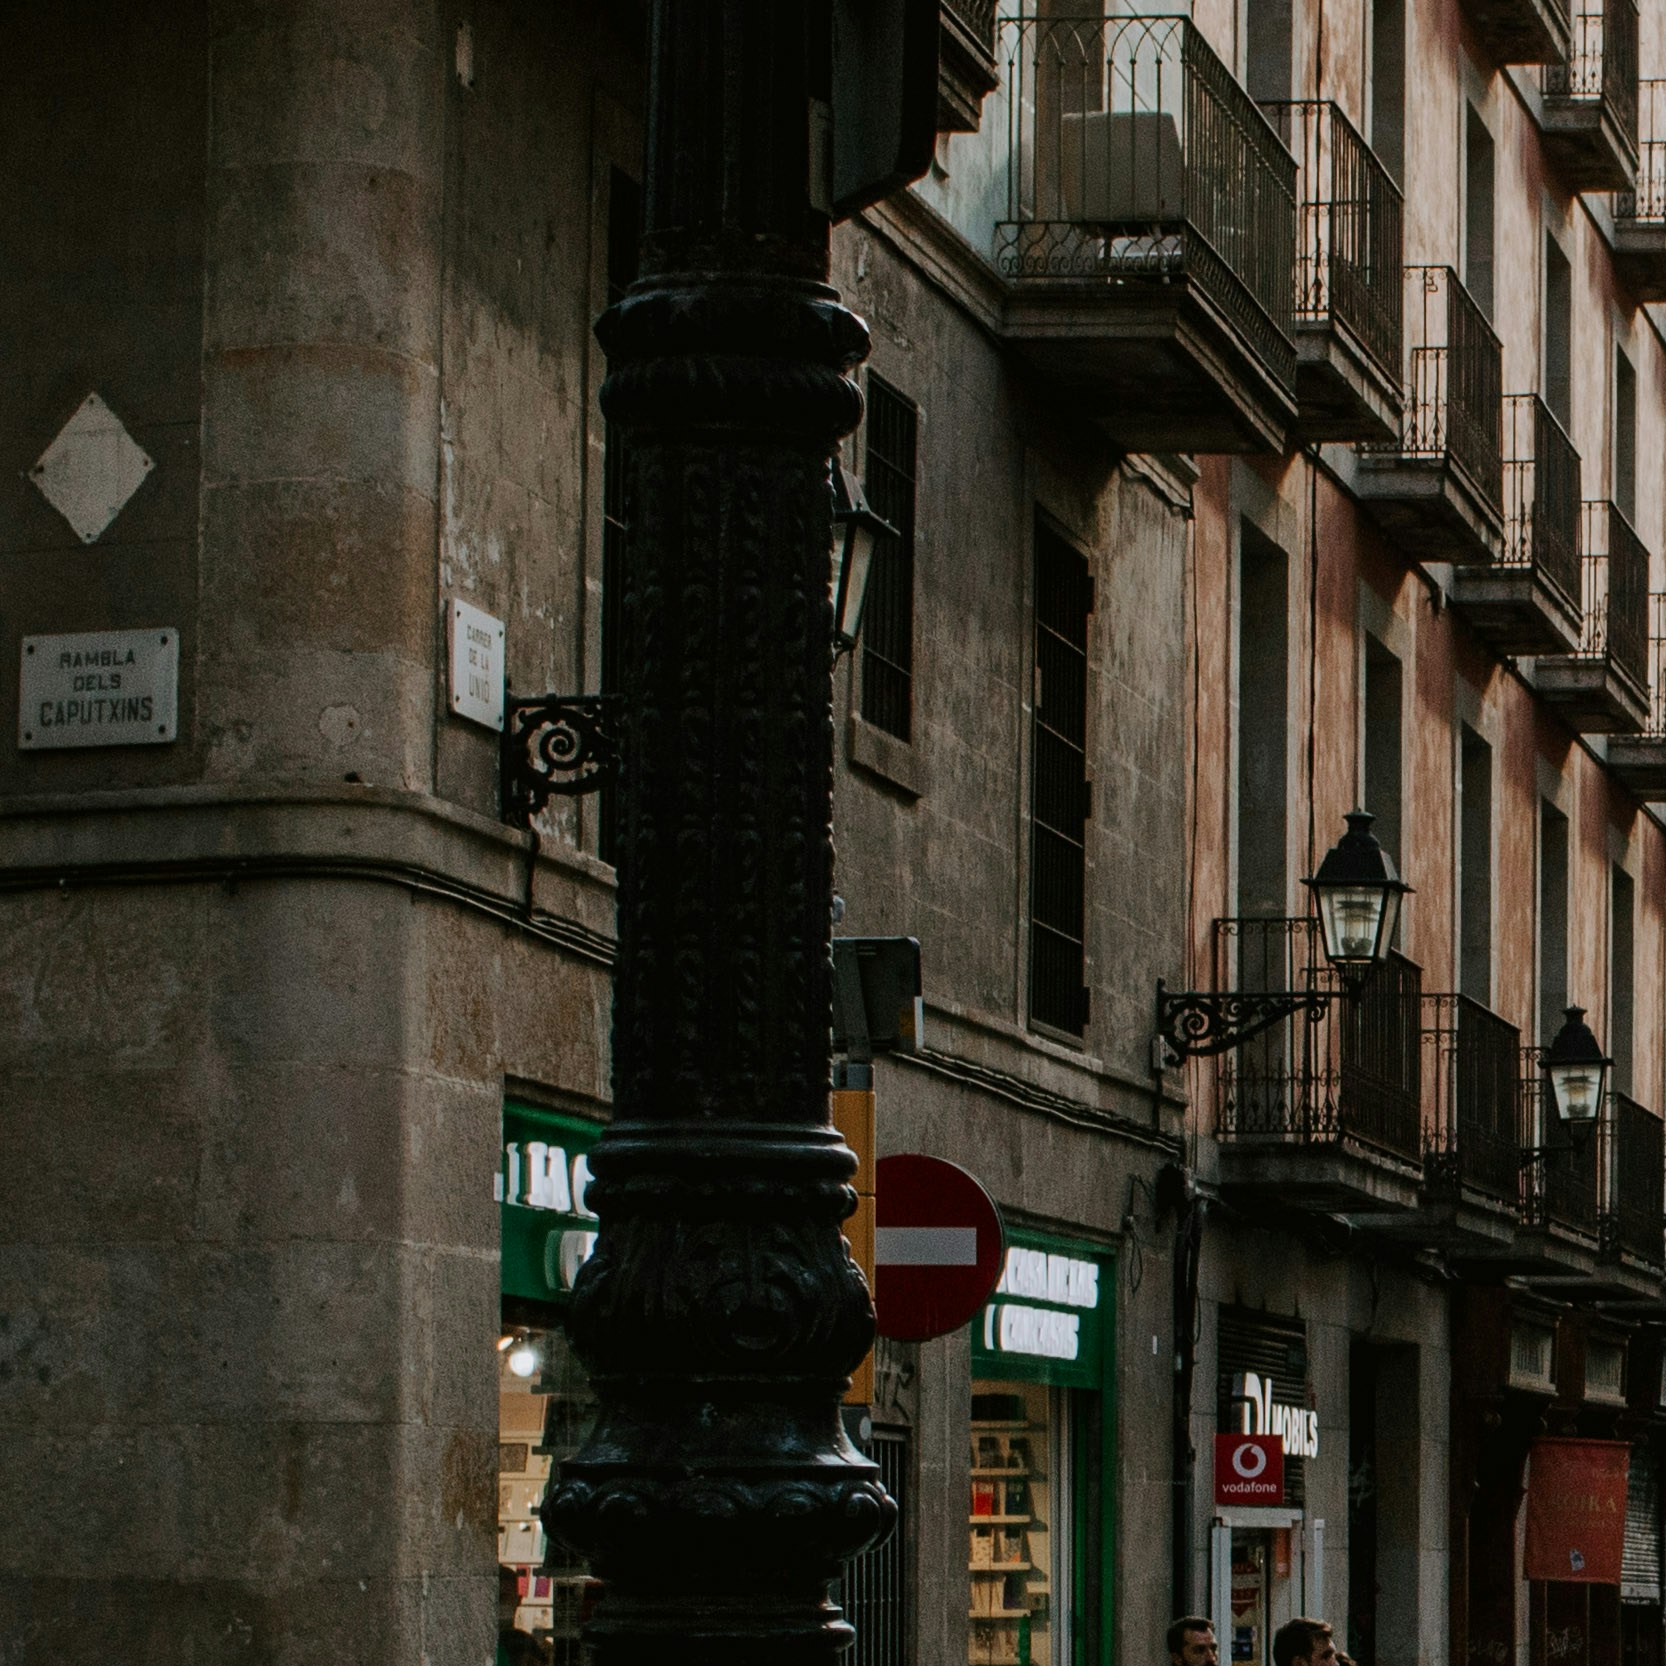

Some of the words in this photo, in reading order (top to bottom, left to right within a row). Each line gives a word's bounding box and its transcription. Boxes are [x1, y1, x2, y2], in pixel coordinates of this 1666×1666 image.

[61, 649, 135, 668] RAMBLA
[469, 648, 477, 666] DE
[74, 674, 121, 691] DELS
[41, 697, 153, 727] CAPUTXINS
[1222, 1482, 1277, 1493] vodafone
